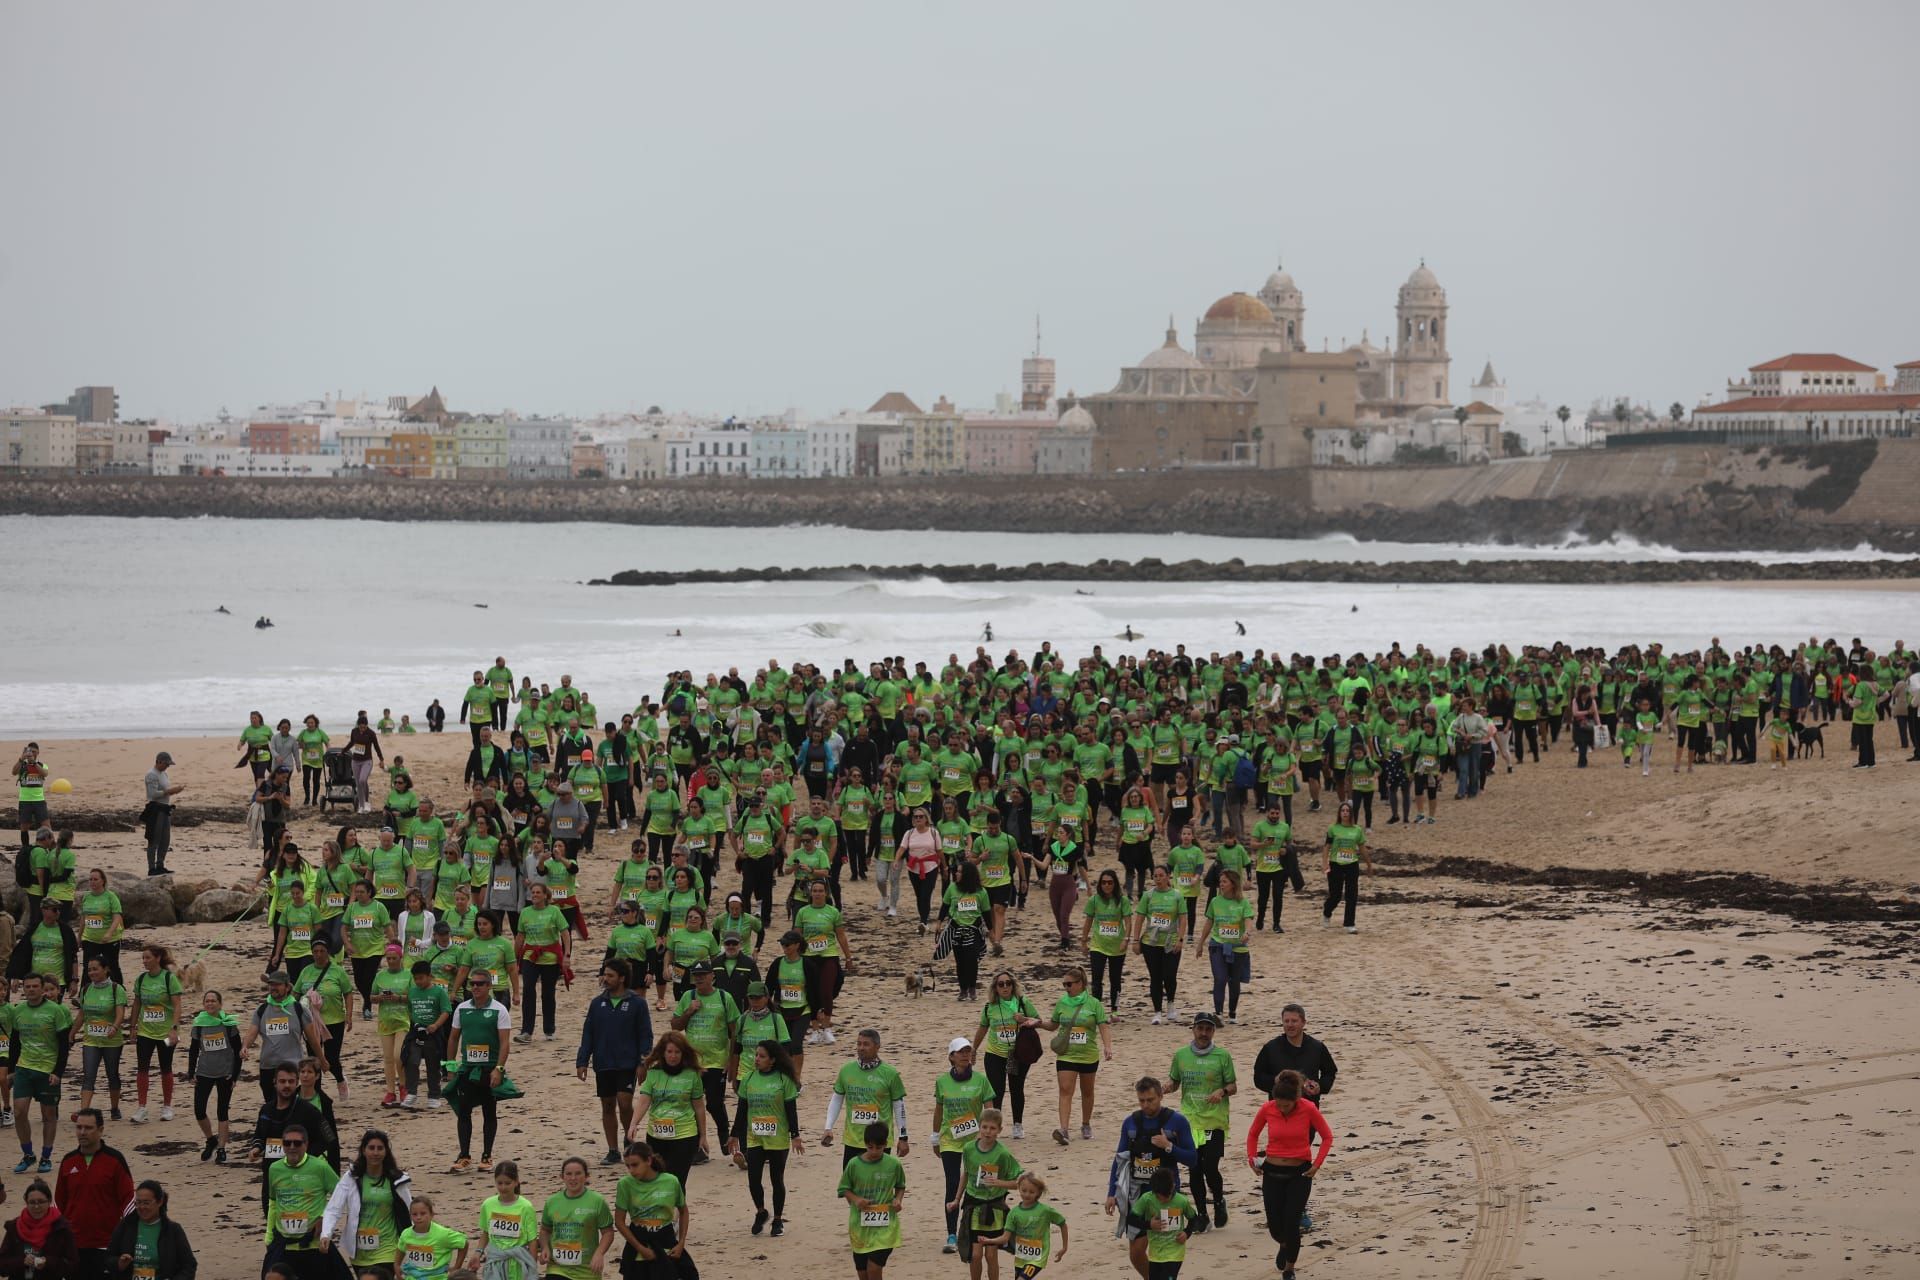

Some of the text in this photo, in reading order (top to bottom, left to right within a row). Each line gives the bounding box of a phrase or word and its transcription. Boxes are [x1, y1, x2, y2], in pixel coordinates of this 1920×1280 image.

[268, 1022, 288, 1031] 4766
[999, 1030, 1015, 1038] 429
[1071, 1032, 1086, 1040] 297
[205, 1039, 225, 1048] 4767
[469, 1050, 488, 1058] 4875
[854, 1111, 877, 1120] 2994
[654, 1125, 674, 1133] 3390
[754, 1122, 776, 1132] 3389
[954, 1119, 977, 1134] 2993
[864, 1212, 889, 1221] 2272
[286, 1219, 303, 1229] 117
[493, 1220, 519, 1231] 4820
[556, 1249, 580, 1260] 3107
[1017, 1245, 1041, 1256] 4590
[408, 1251, 432, 1263] 4819
